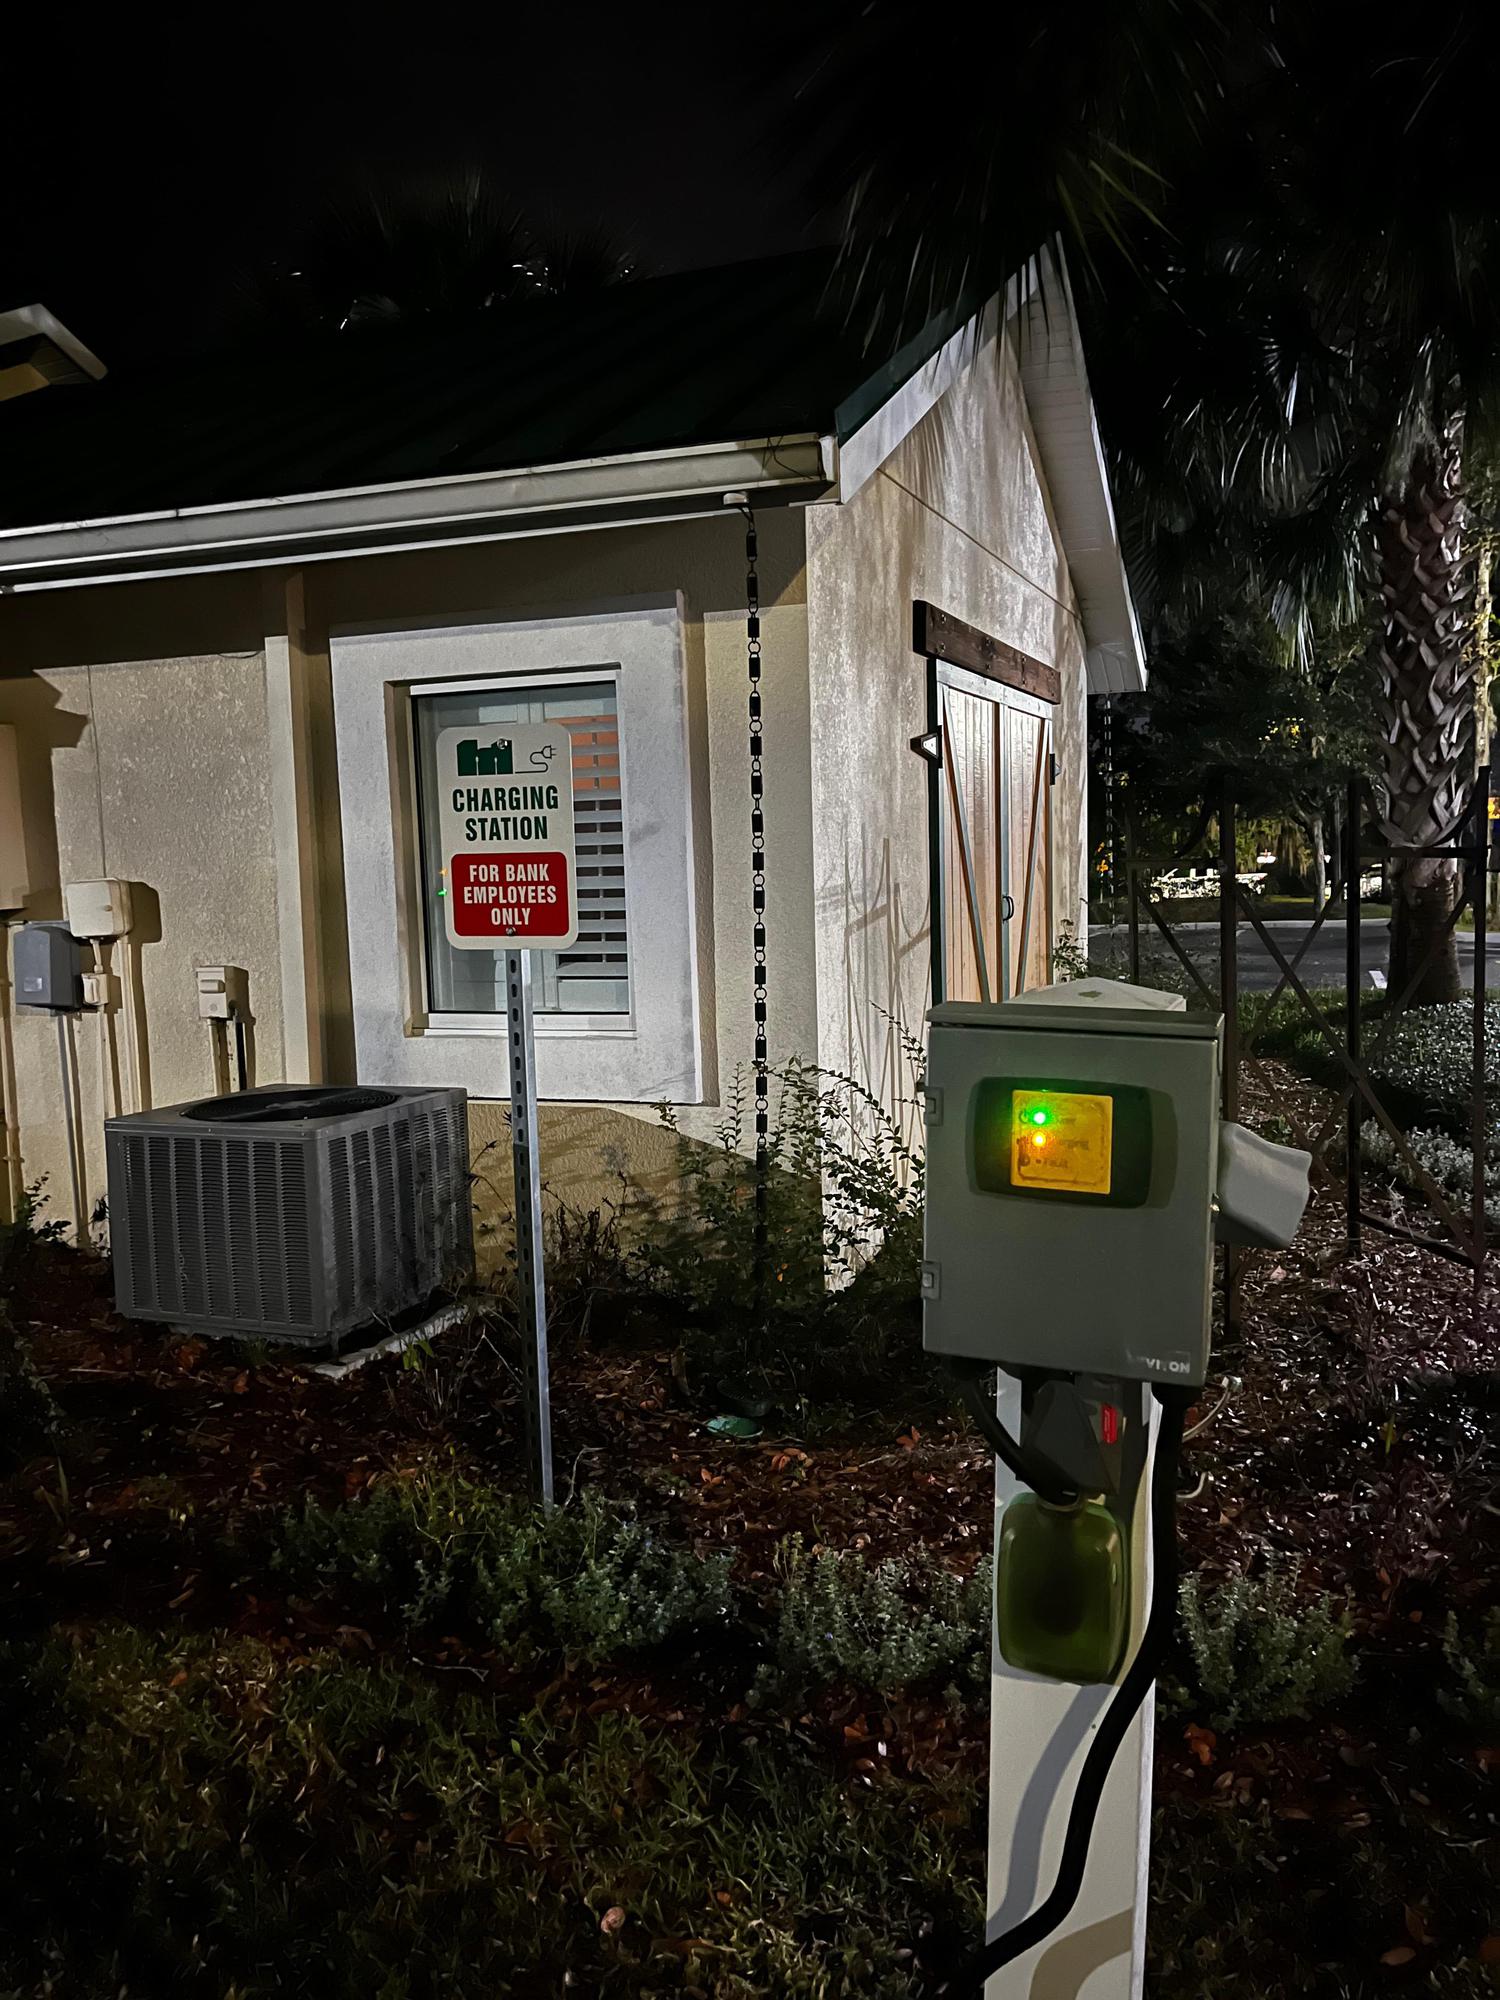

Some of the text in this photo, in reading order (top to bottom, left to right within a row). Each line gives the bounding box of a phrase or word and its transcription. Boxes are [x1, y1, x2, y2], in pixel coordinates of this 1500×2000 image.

[452, 785, 559, 813] CHARGING
[465, 816, 548, 841] STATION
[469, 863, 550, 883] FOR BANK
[463, 885, 557, 905] EMPLOYEES
[491, 907, 531, 926] ONLY
